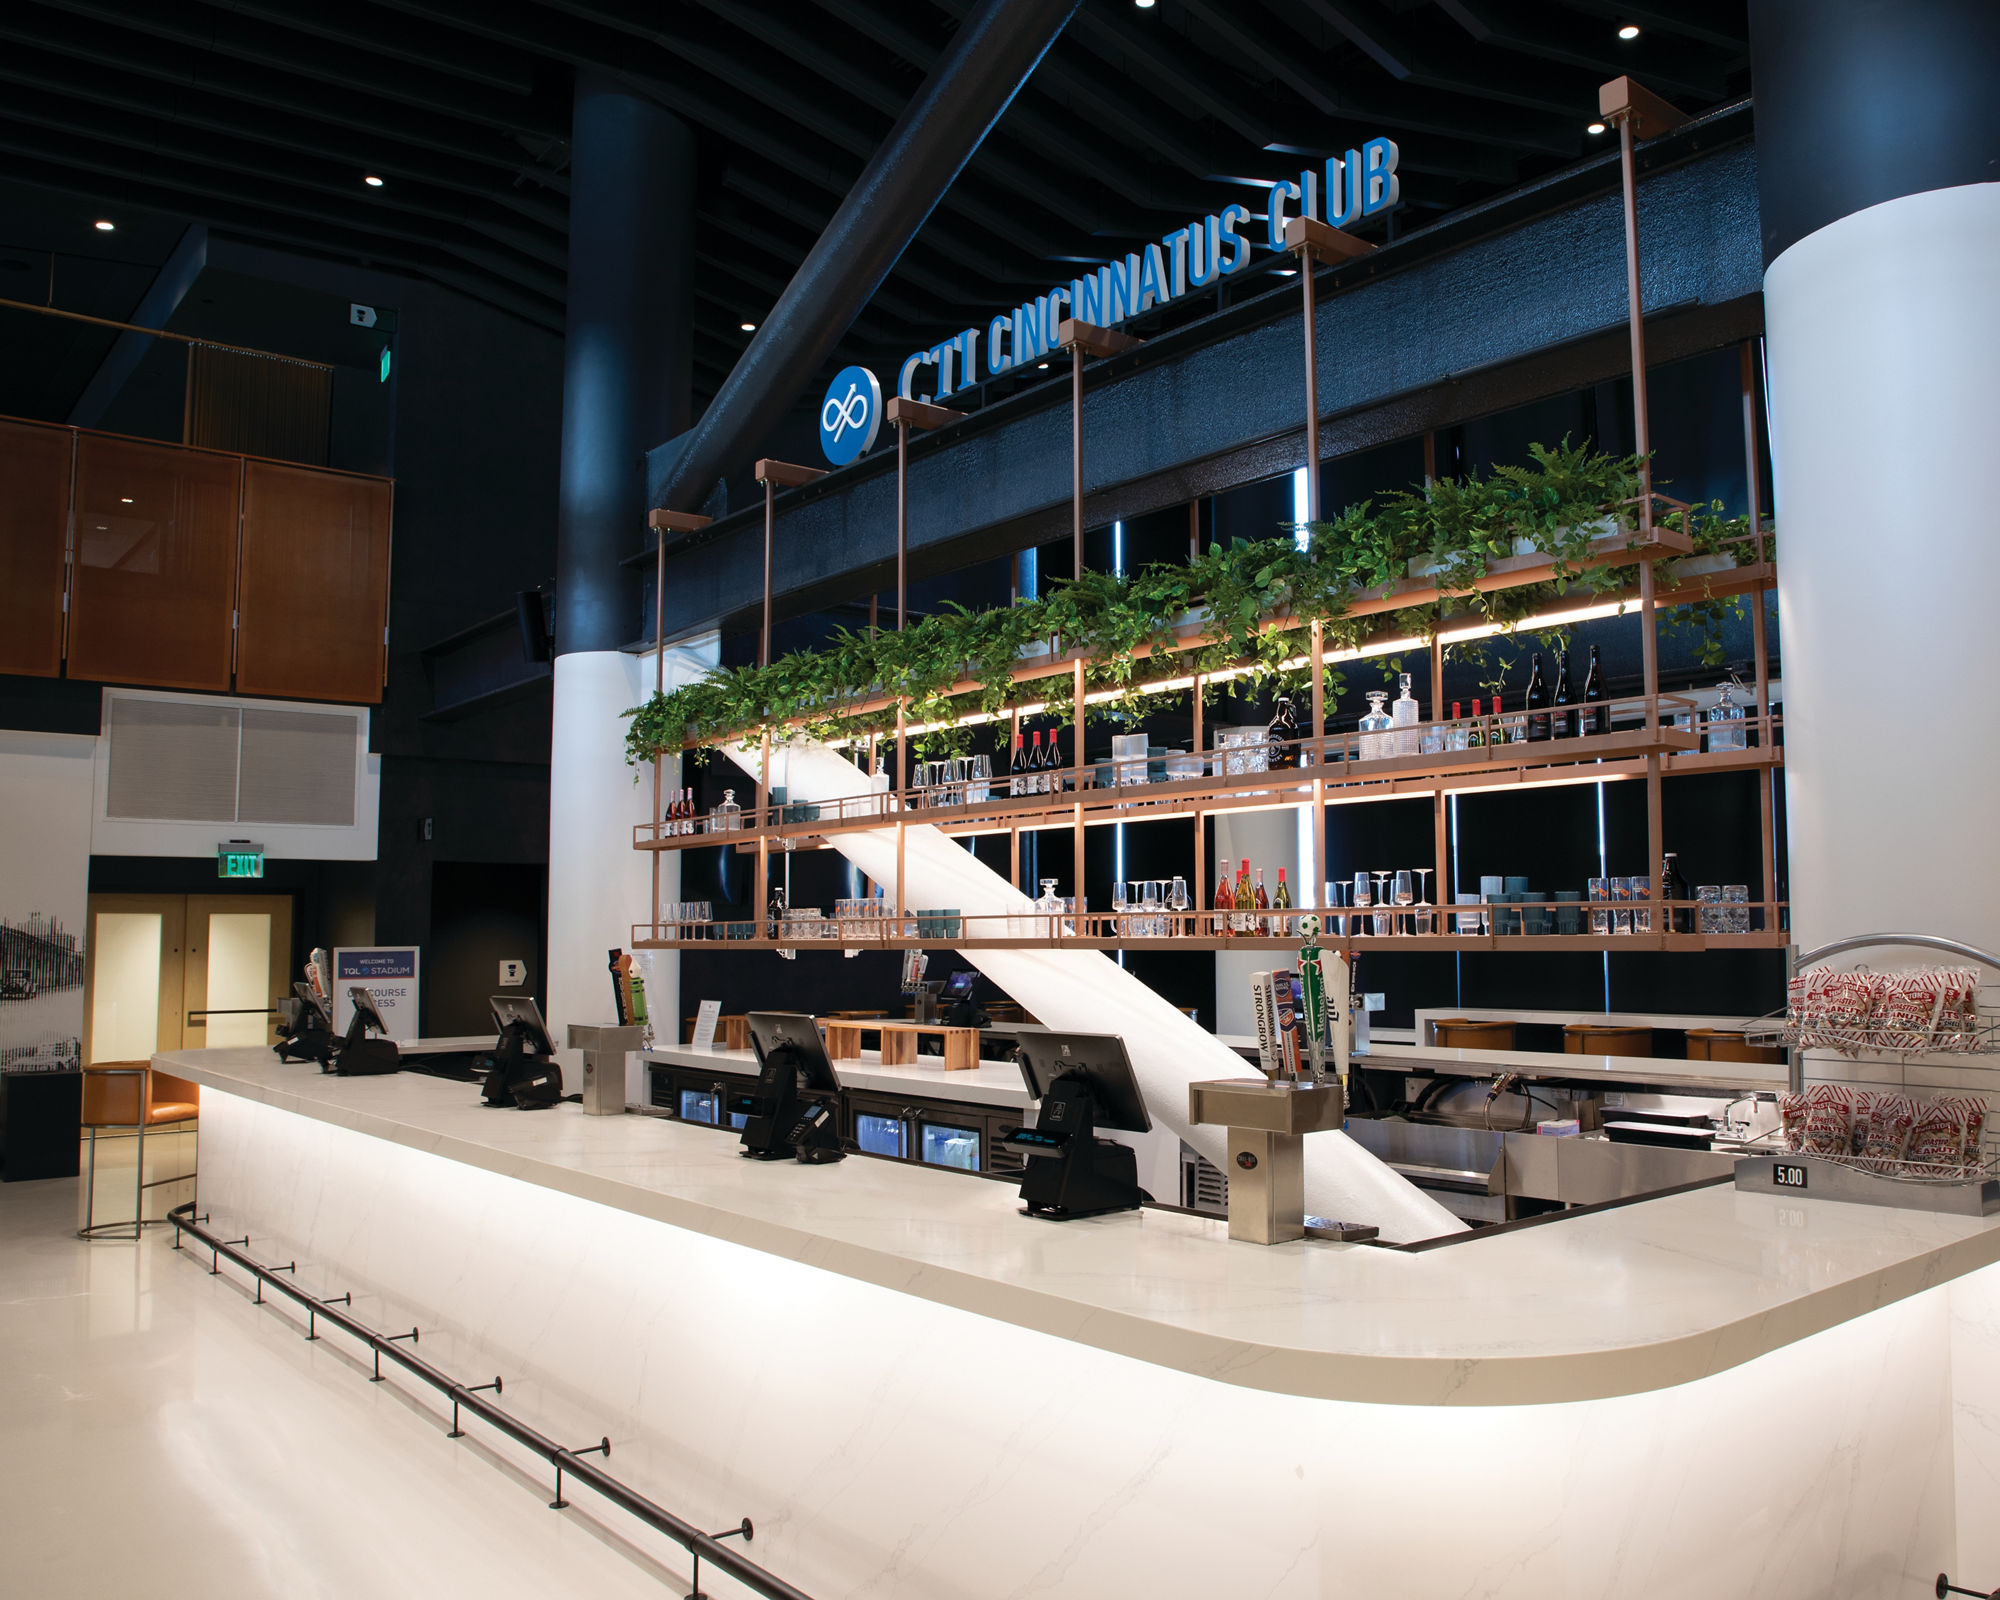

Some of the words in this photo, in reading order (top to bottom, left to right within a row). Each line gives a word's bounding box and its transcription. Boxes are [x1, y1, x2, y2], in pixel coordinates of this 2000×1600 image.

[897, 327, 981, 402] CTI
[988, 203, 1251, 375] CINCINNATUS
[227, 854, 258, 876] EXIT
[343, 967, 361, 975] TQL
[370, 966, 410, 975] STADIUM
[1253, 984, 1269, 1053] STRONGBOW
[1265, 984, 1276, 1037] STRONGBOW
[1317, 977, 1326, 1033] Heineken
[1807, 1124, 1849, 1136] EANUTS
[1777, 1166, 1803, 1185] 5.00
